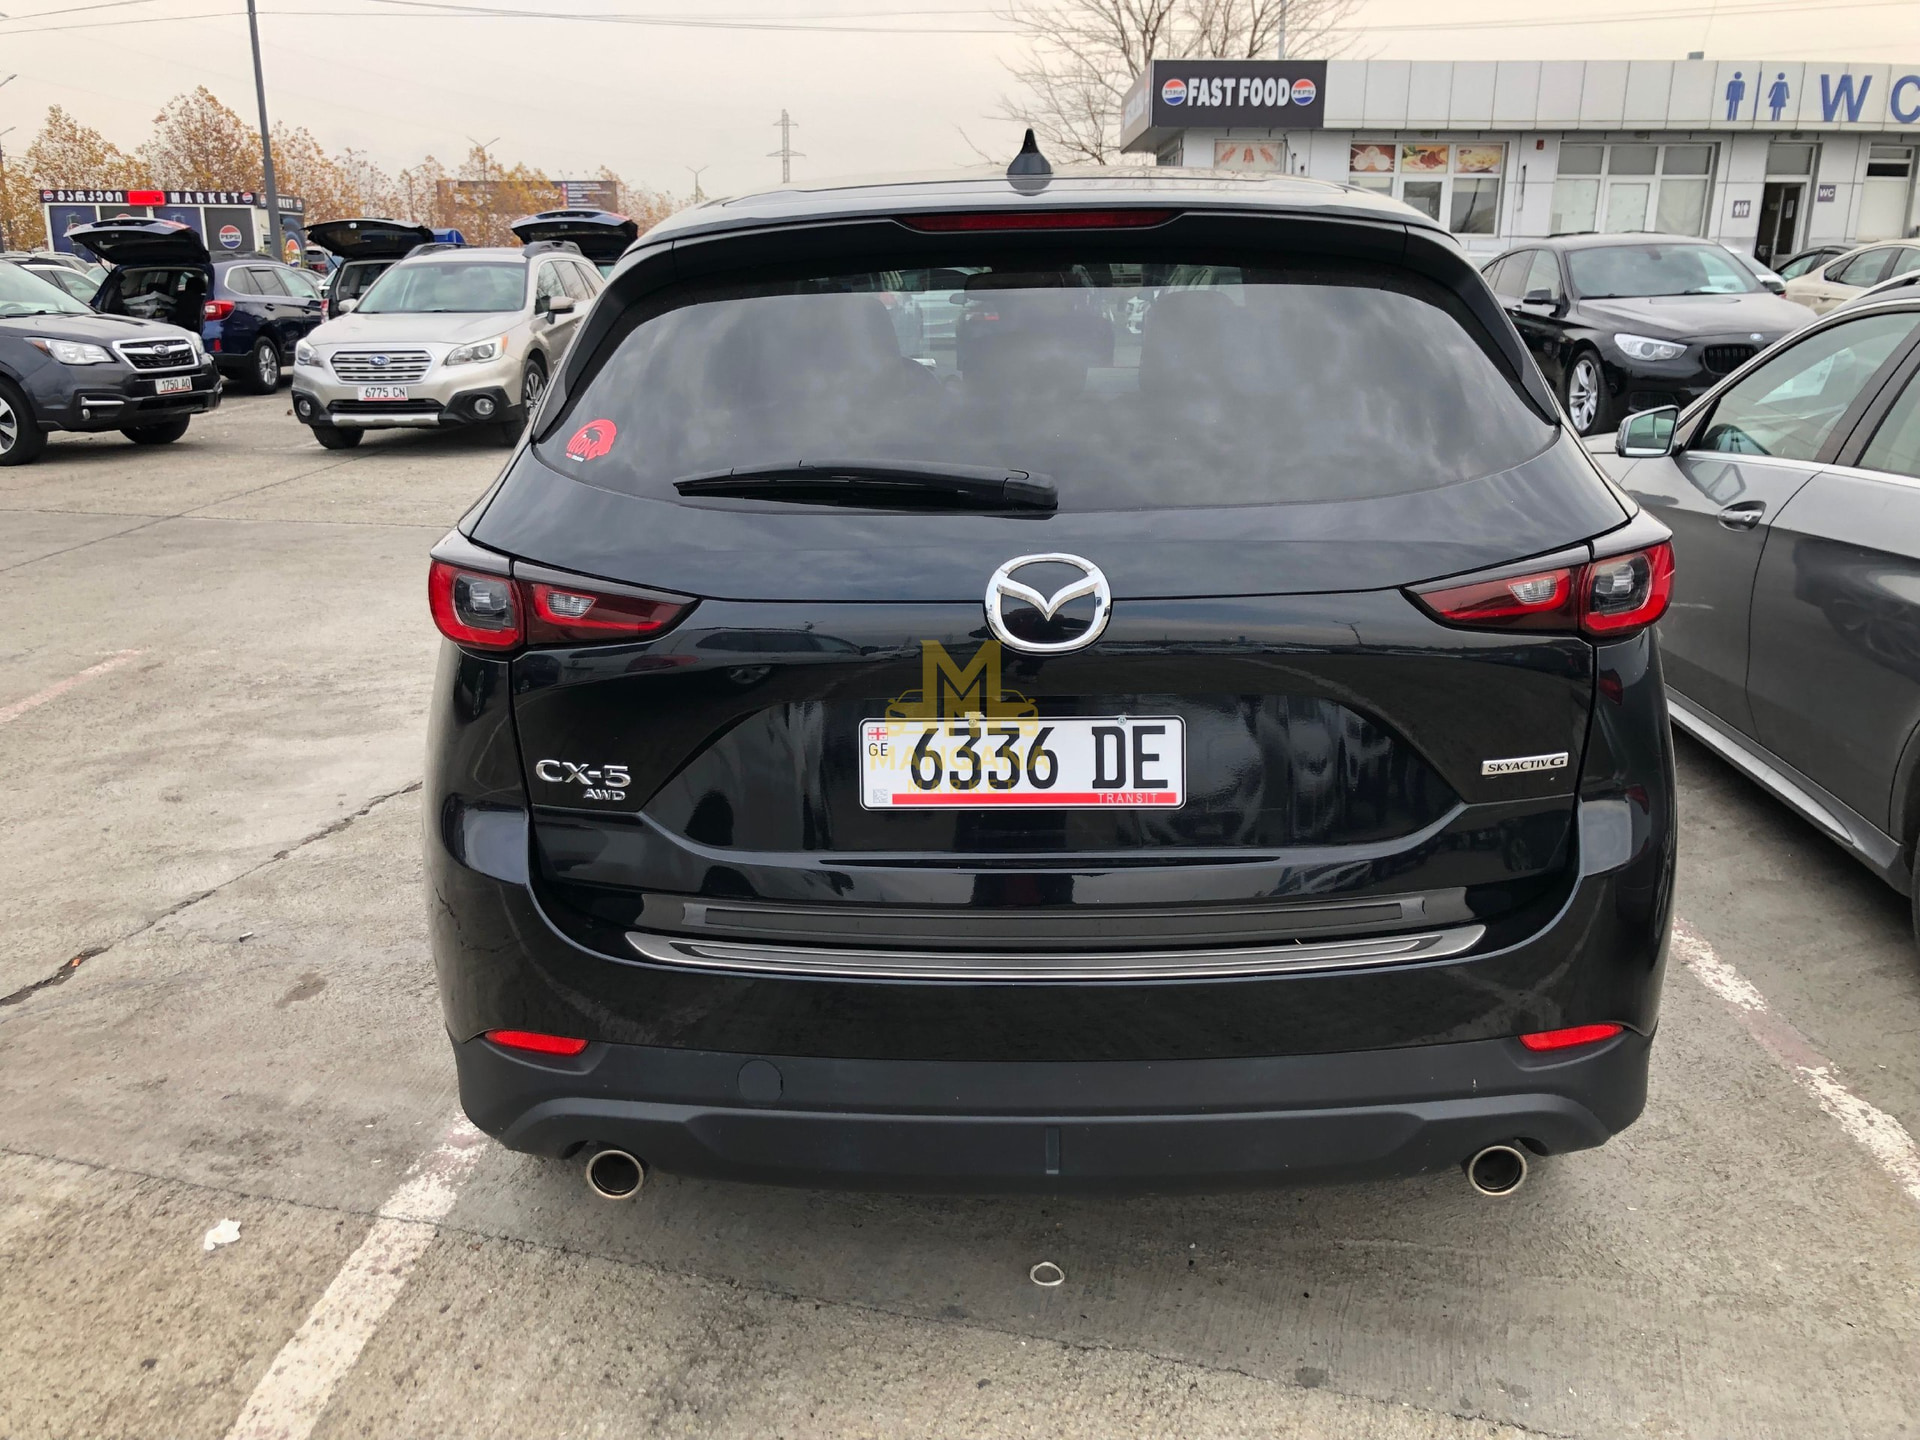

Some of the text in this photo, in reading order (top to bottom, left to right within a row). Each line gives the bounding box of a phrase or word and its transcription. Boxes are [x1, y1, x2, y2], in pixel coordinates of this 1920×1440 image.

[1187, 77, 1291, 107] FAST FOOD
[1820, 74, 1920, 124] WC
[170, 192, 240, 204] MARKET
[1819, 188, 1835, 198] WC
[365, 386, 406, 398] 6775 CN
[868, 743, 889, 757] GE
[911, 725, 1169, 790] 6336 DE
[535, 759, 632, 788] CX-5
[583, 788, 626, 801] AWD
[1097, 792, 1158, 804] TRANSIT
